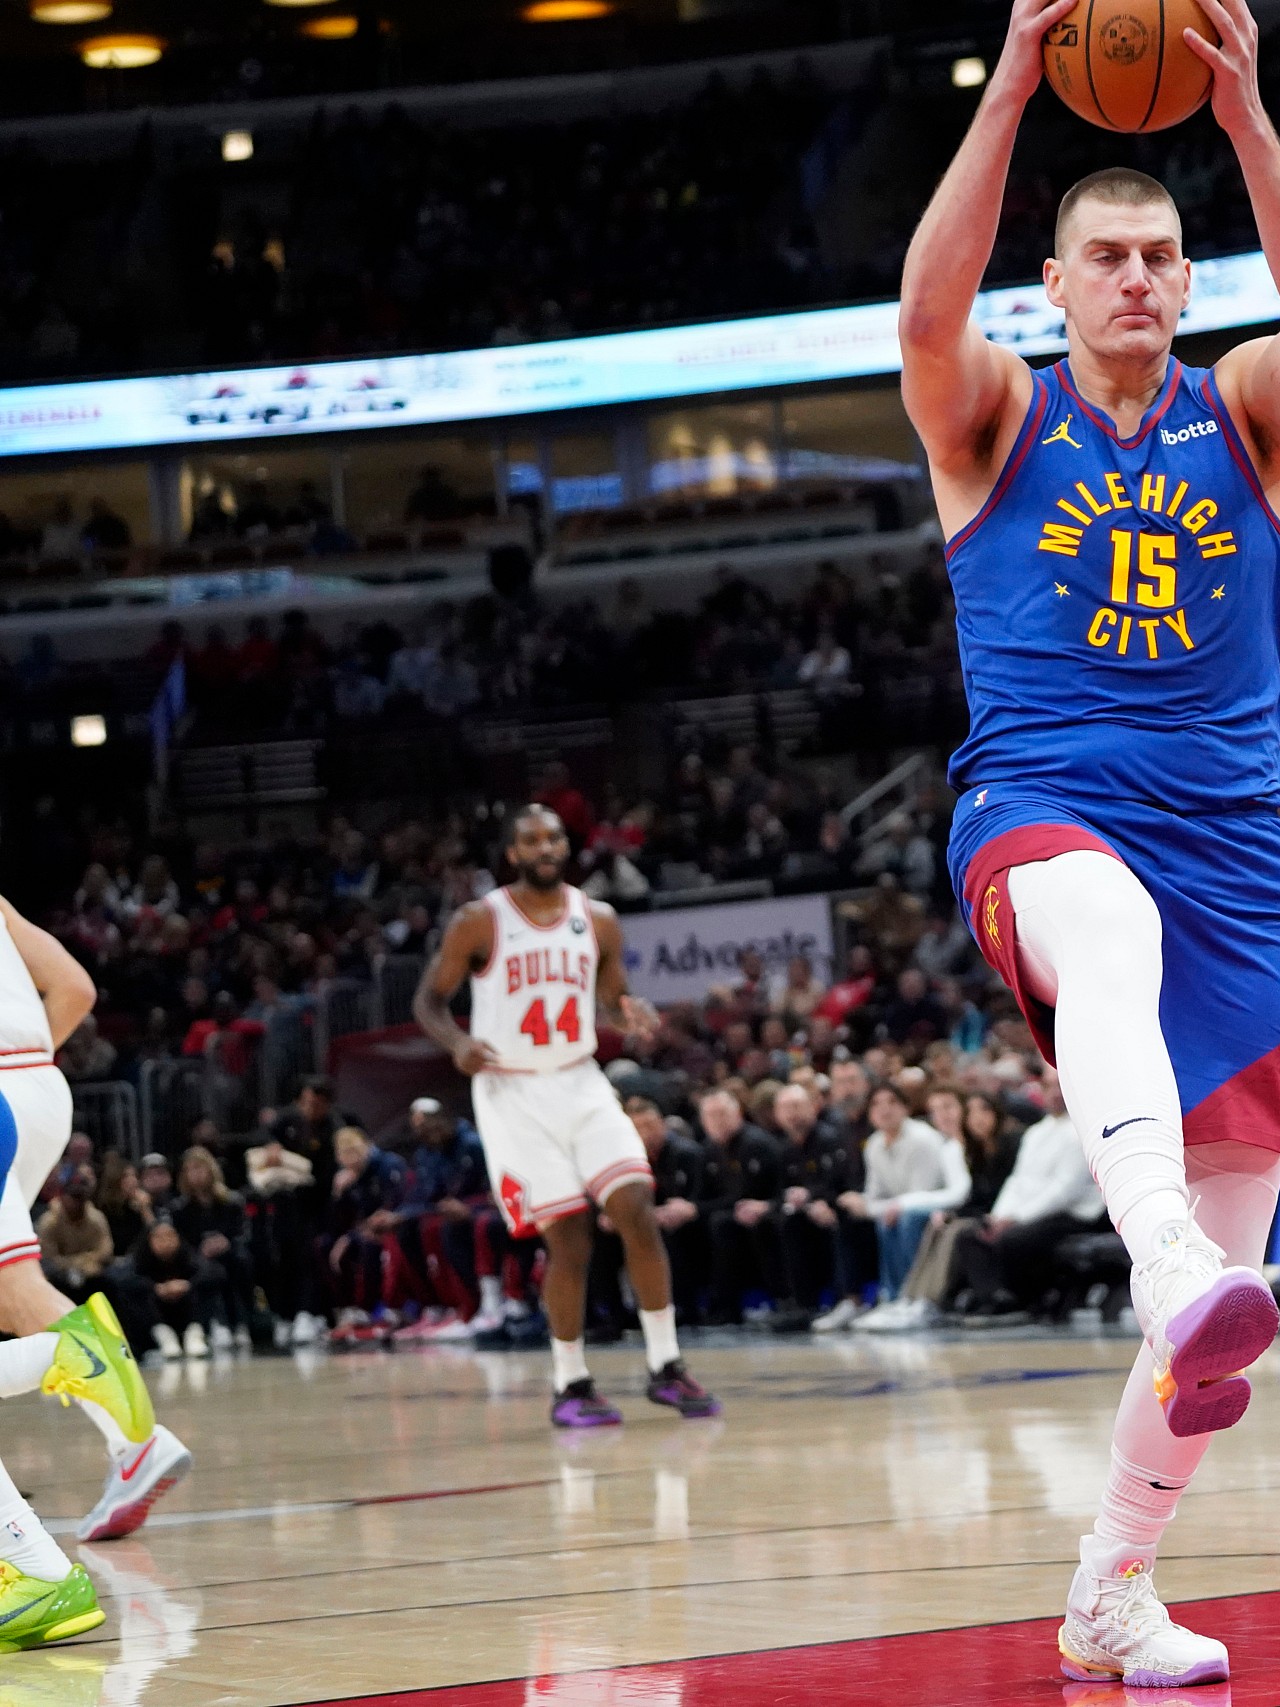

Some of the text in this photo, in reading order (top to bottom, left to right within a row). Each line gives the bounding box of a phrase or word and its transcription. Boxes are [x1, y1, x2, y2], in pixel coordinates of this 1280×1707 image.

[1160, 420, 1218, 445] ibotta
[1038, 472, 1238, 560] MILE HIGH
[1110, 529, 1176, 609] 15
[1087, 607, 1195, 659] CITY
[506, 947, 590, 995] BULLS
[520, 996, 581, 1046] 44
